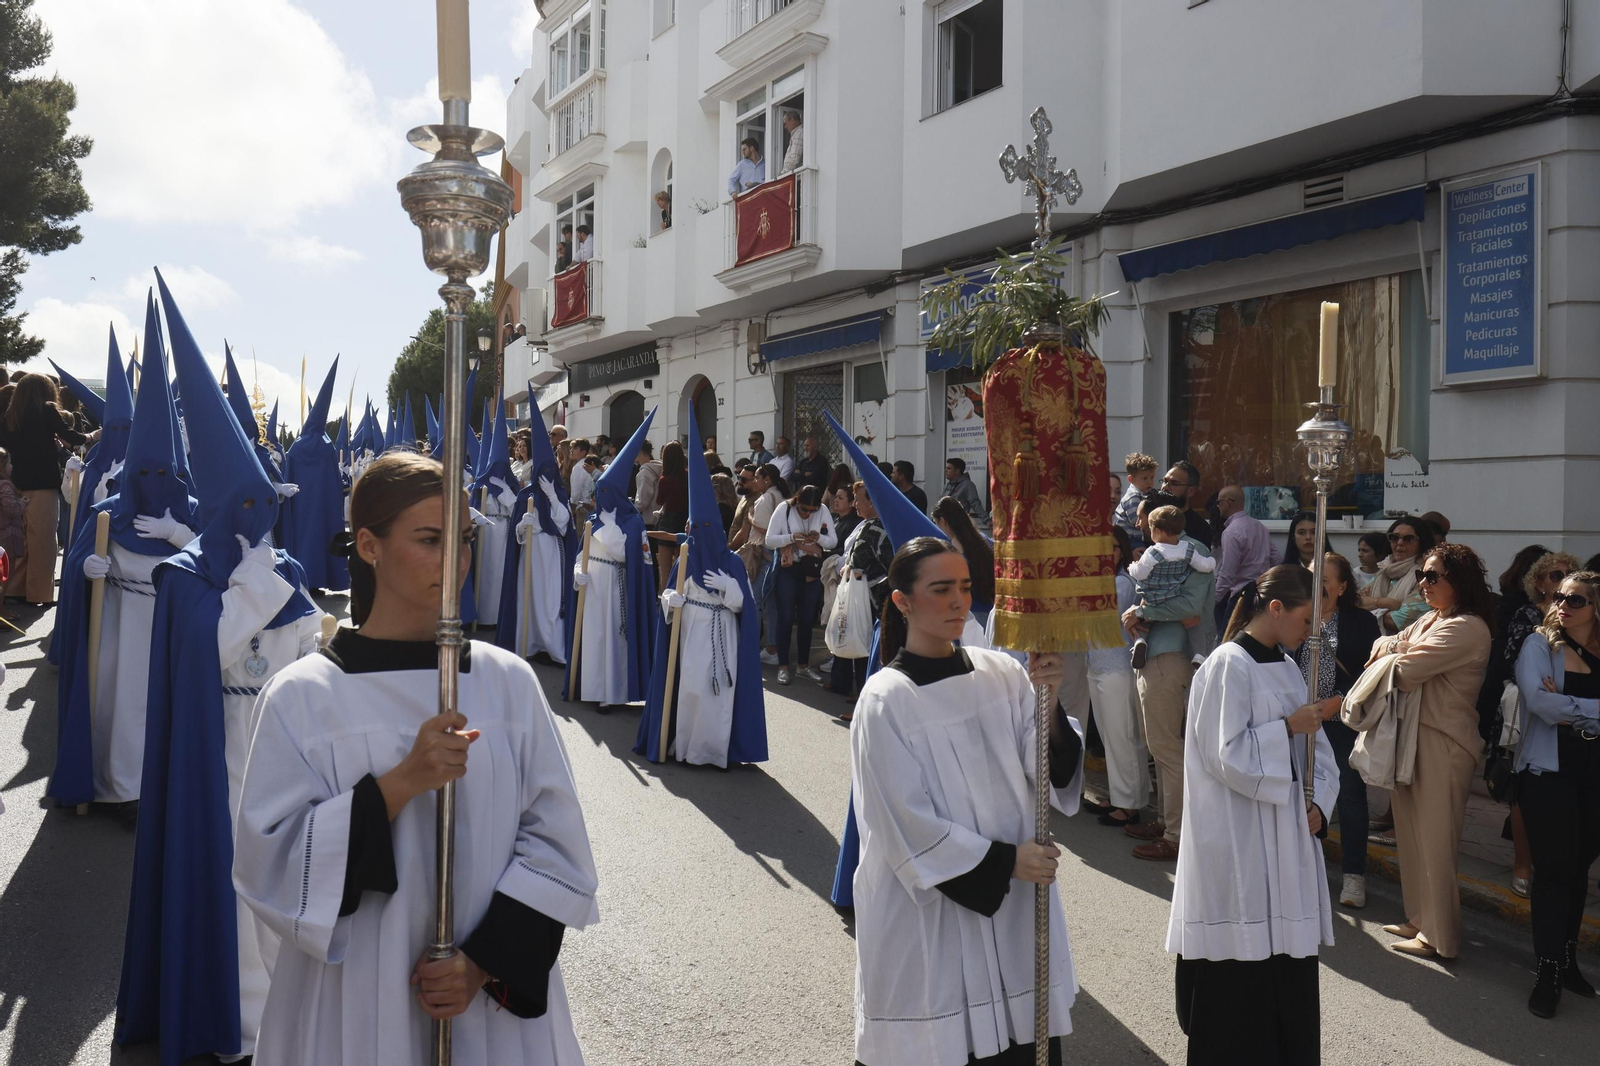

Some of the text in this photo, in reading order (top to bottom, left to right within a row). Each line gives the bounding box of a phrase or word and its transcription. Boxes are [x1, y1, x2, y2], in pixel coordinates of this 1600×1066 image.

[1454, 182, 1526, 206] Wellness Center
[1458, 202, 1526, 225] Depilaciones
[1457, 221, 1528, 243] Tratamientos
[1471, 237, 1513, 254] Faciales
[1457, 254, 1528, 274] Tratamientos
[1463, 268, 1521, 288] Corporales
[1470, 288, 1513, 304] Masajes
[1464, 307, 1520, 323] Manicuras
[1465, 326, 1518, 342] Pedicuras
[1463, 343, 1520, 361] Maquillaje
[588, 351, 656, 379] PINO & JACARANDA
